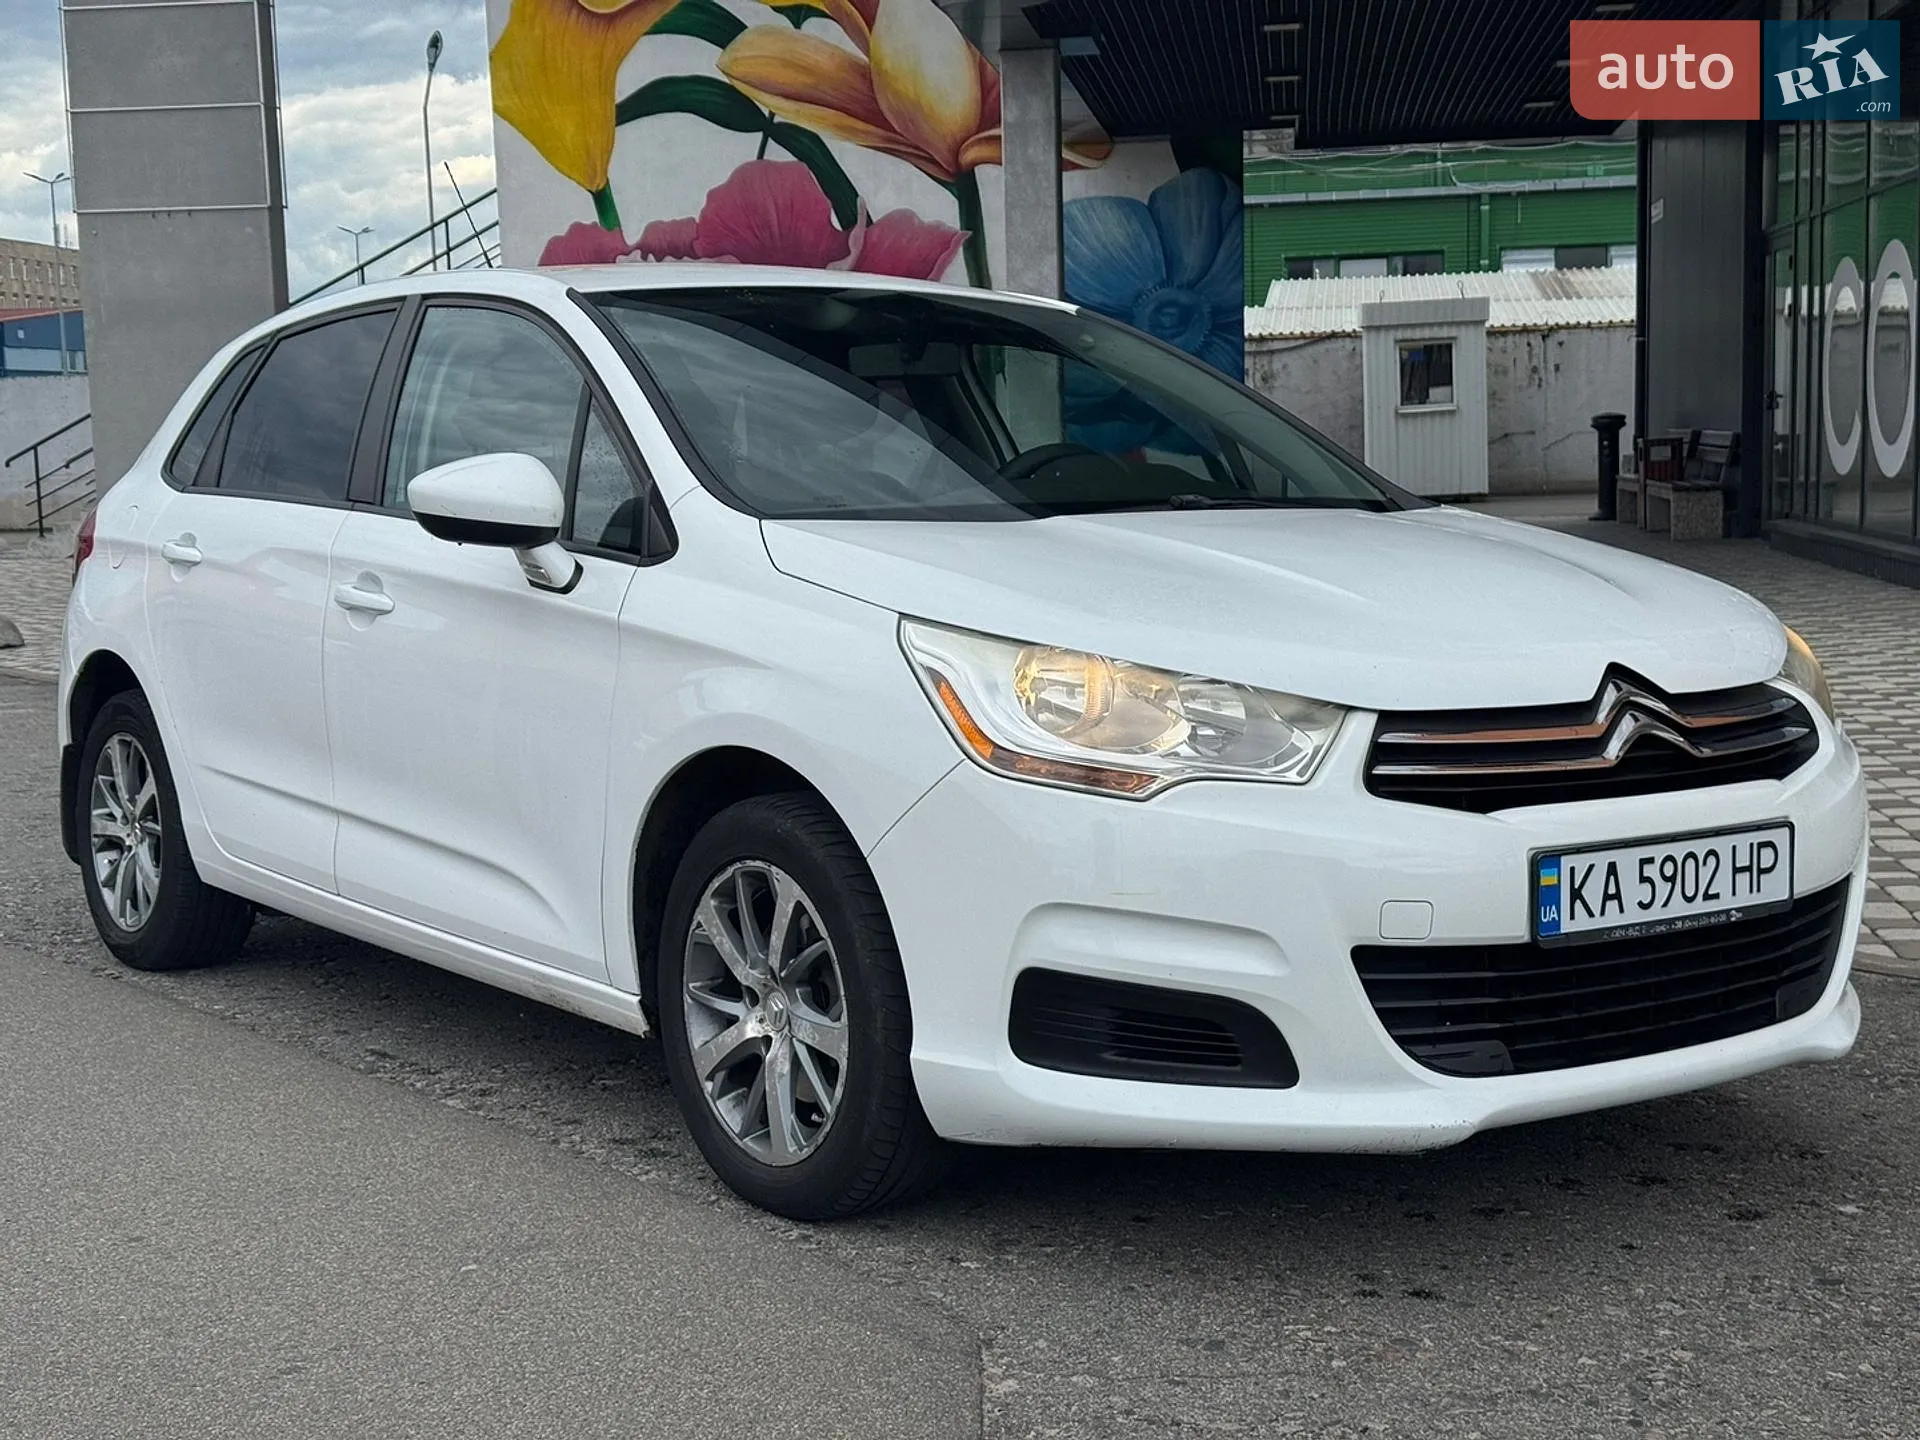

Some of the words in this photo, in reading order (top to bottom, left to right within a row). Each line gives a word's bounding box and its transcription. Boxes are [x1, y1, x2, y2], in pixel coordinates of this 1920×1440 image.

[1569, 861, 1624, 921] KA
[1637, 848, 1720, 910] 5902
[1731, 840, 1779, 897] HP
[1541, 904, 1559, 922] UA
